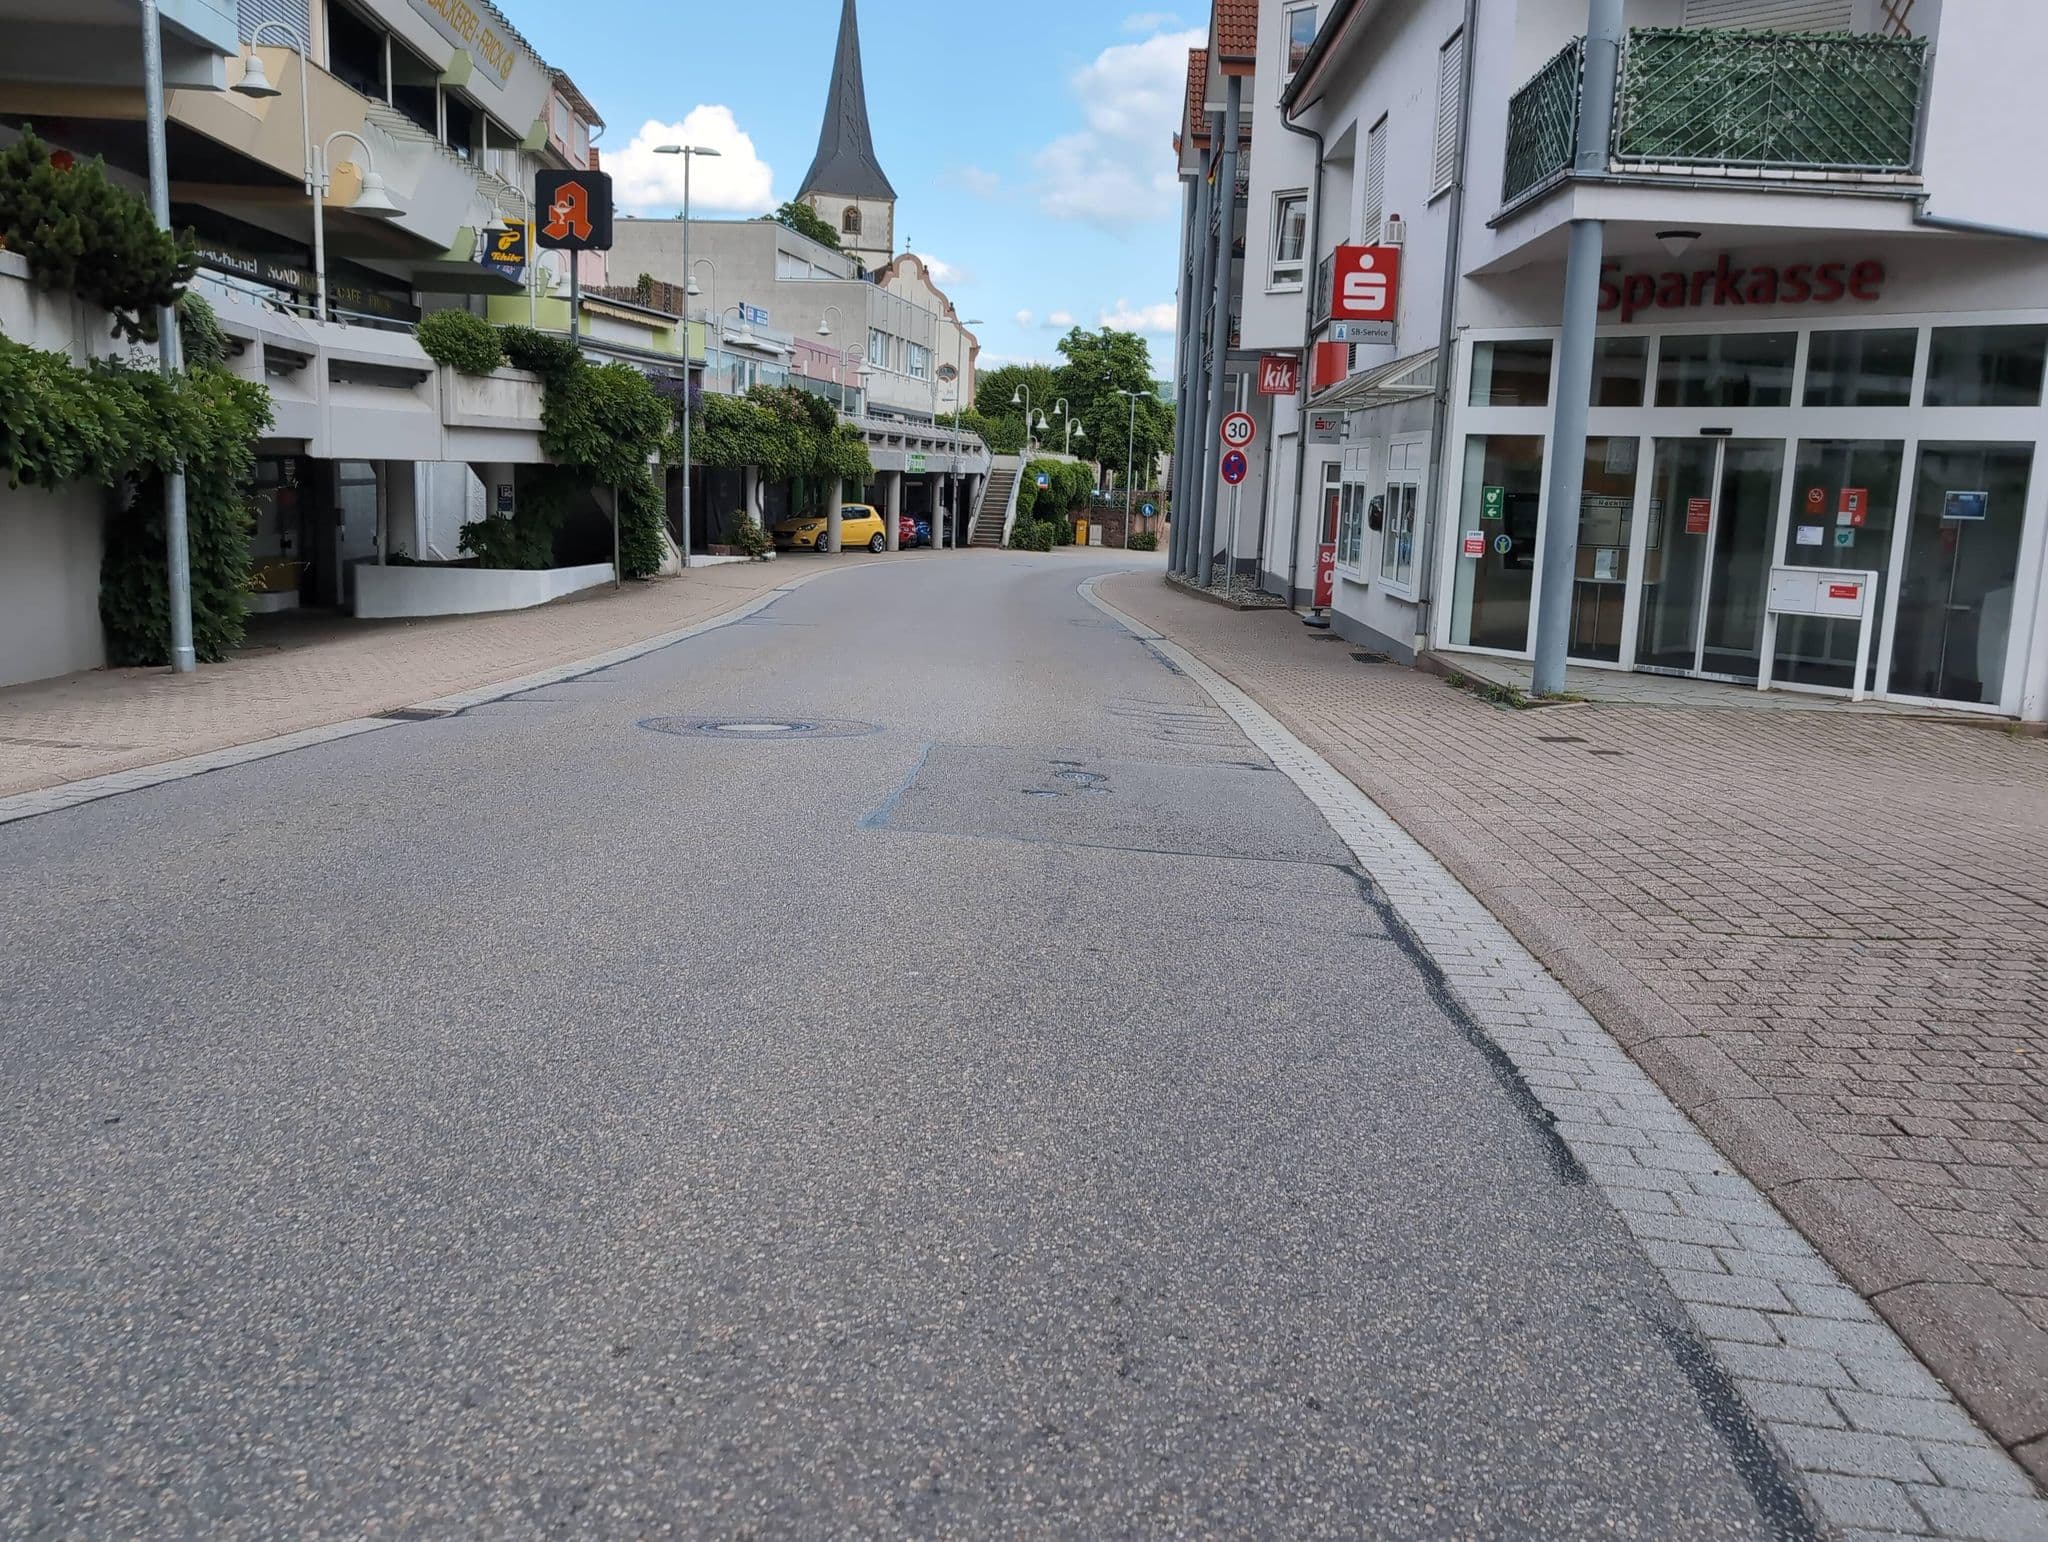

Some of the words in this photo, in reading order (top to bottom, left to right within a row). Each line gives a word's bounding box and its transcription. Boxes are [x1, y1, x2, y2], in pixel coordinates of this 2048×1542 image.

[491, 251, 523, 263] Tchibo
[1597, 253, 1885, 323] Sparkasse
[1350, 327, 1389, 338] SB-Service
[1228, 422, 1248, 439] 30
